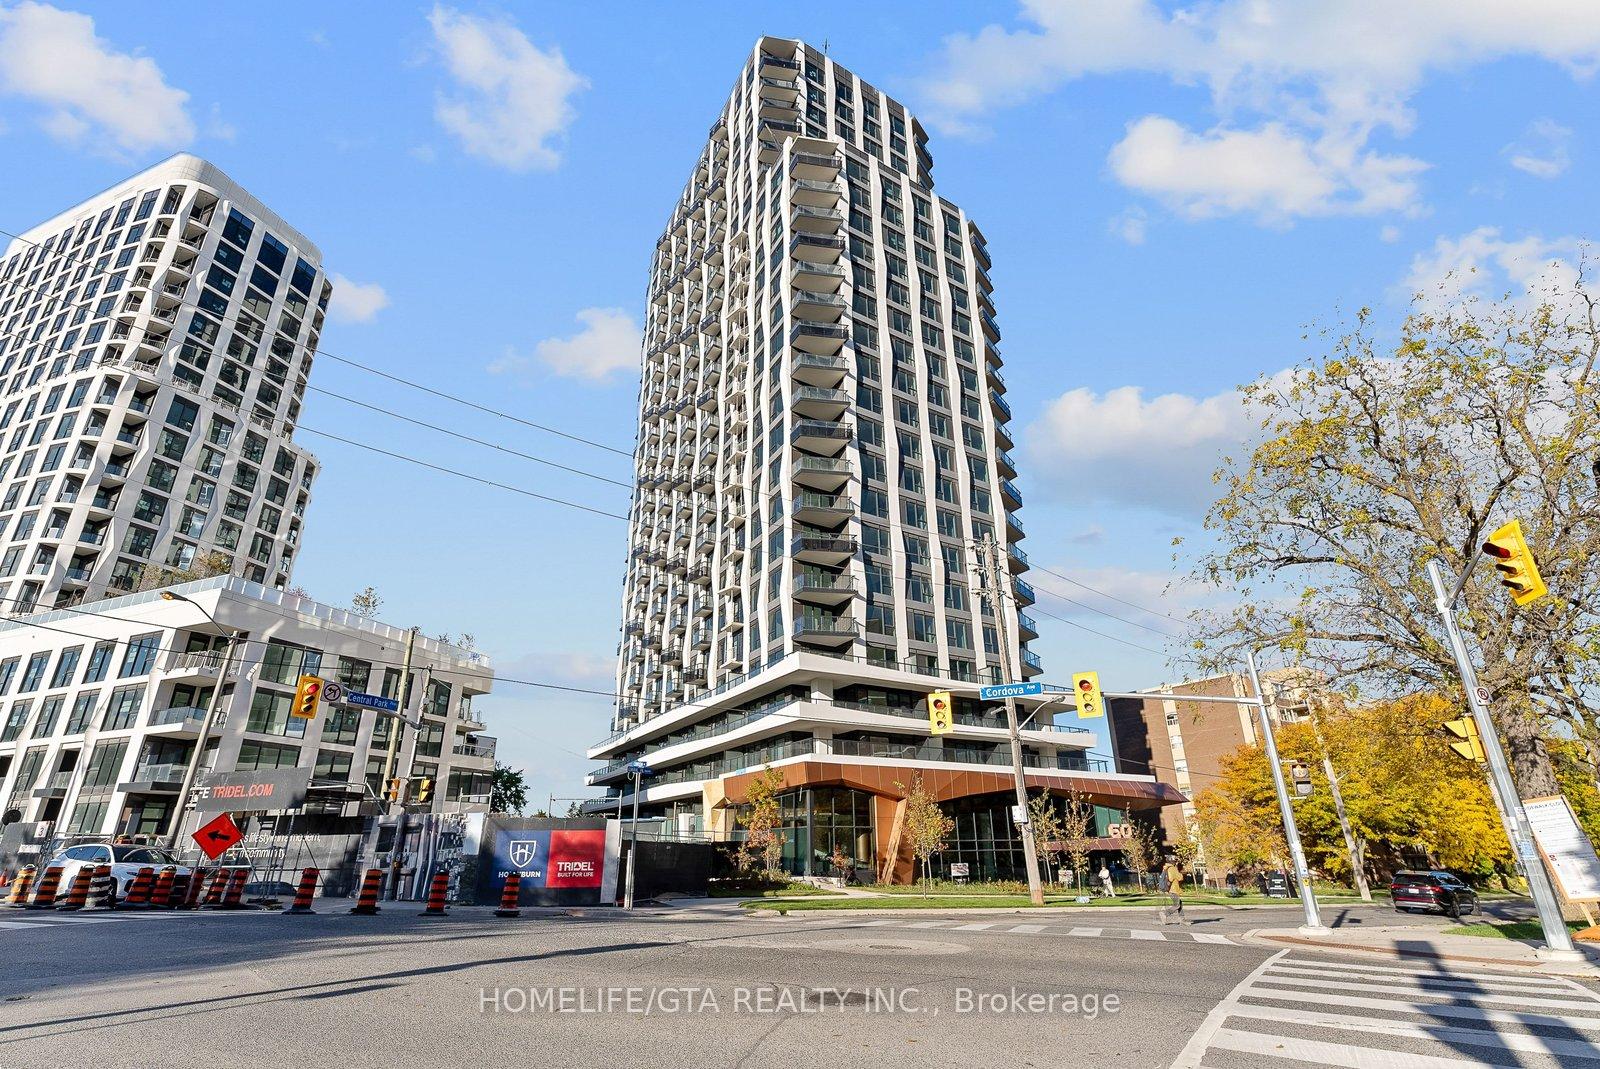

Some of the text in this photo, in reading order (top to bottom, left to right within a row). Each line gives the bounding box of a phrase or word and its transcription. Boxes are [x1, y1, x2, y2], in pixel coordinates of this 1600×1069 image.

[986, 687, 1024, 697] Cordova
[348, 693, 372, 705] Central
[374, 698, 388, 707] Park
[212, 784, 274, 798] TRIDEL.COM
[557, 862, 594, 871] TRIDEL
